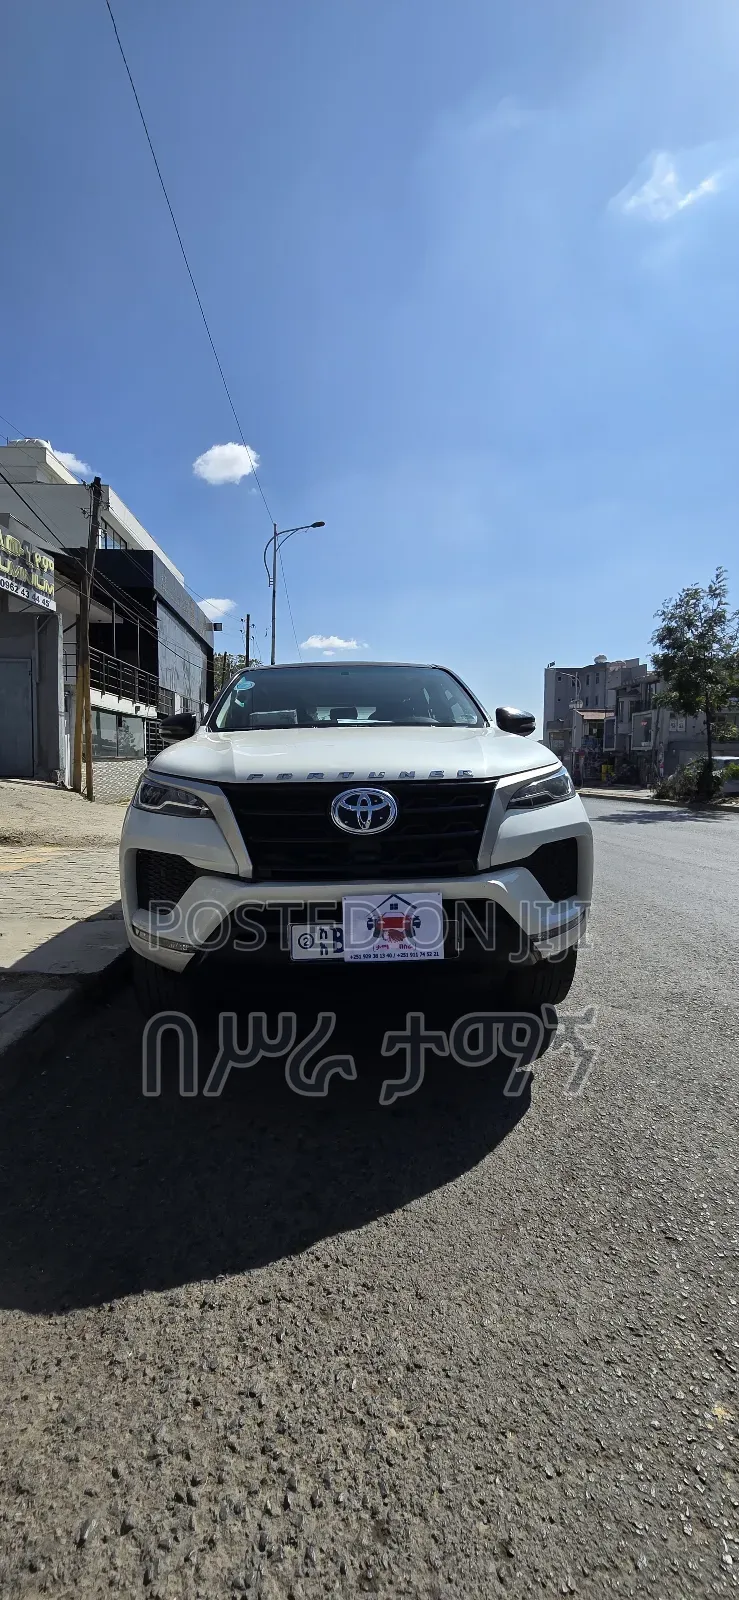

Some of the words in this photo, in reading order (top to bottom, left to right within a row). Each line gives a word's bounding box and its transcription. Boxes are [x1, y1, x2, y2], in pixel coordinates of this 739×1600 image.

[0, 578, 18, 594] 0962
[20, 588, 30, 599] 43
[31, 595, 40, 604] 44
[41, 598, 50, 608] 45
[246, 769, 475, 781] FORTUNER
